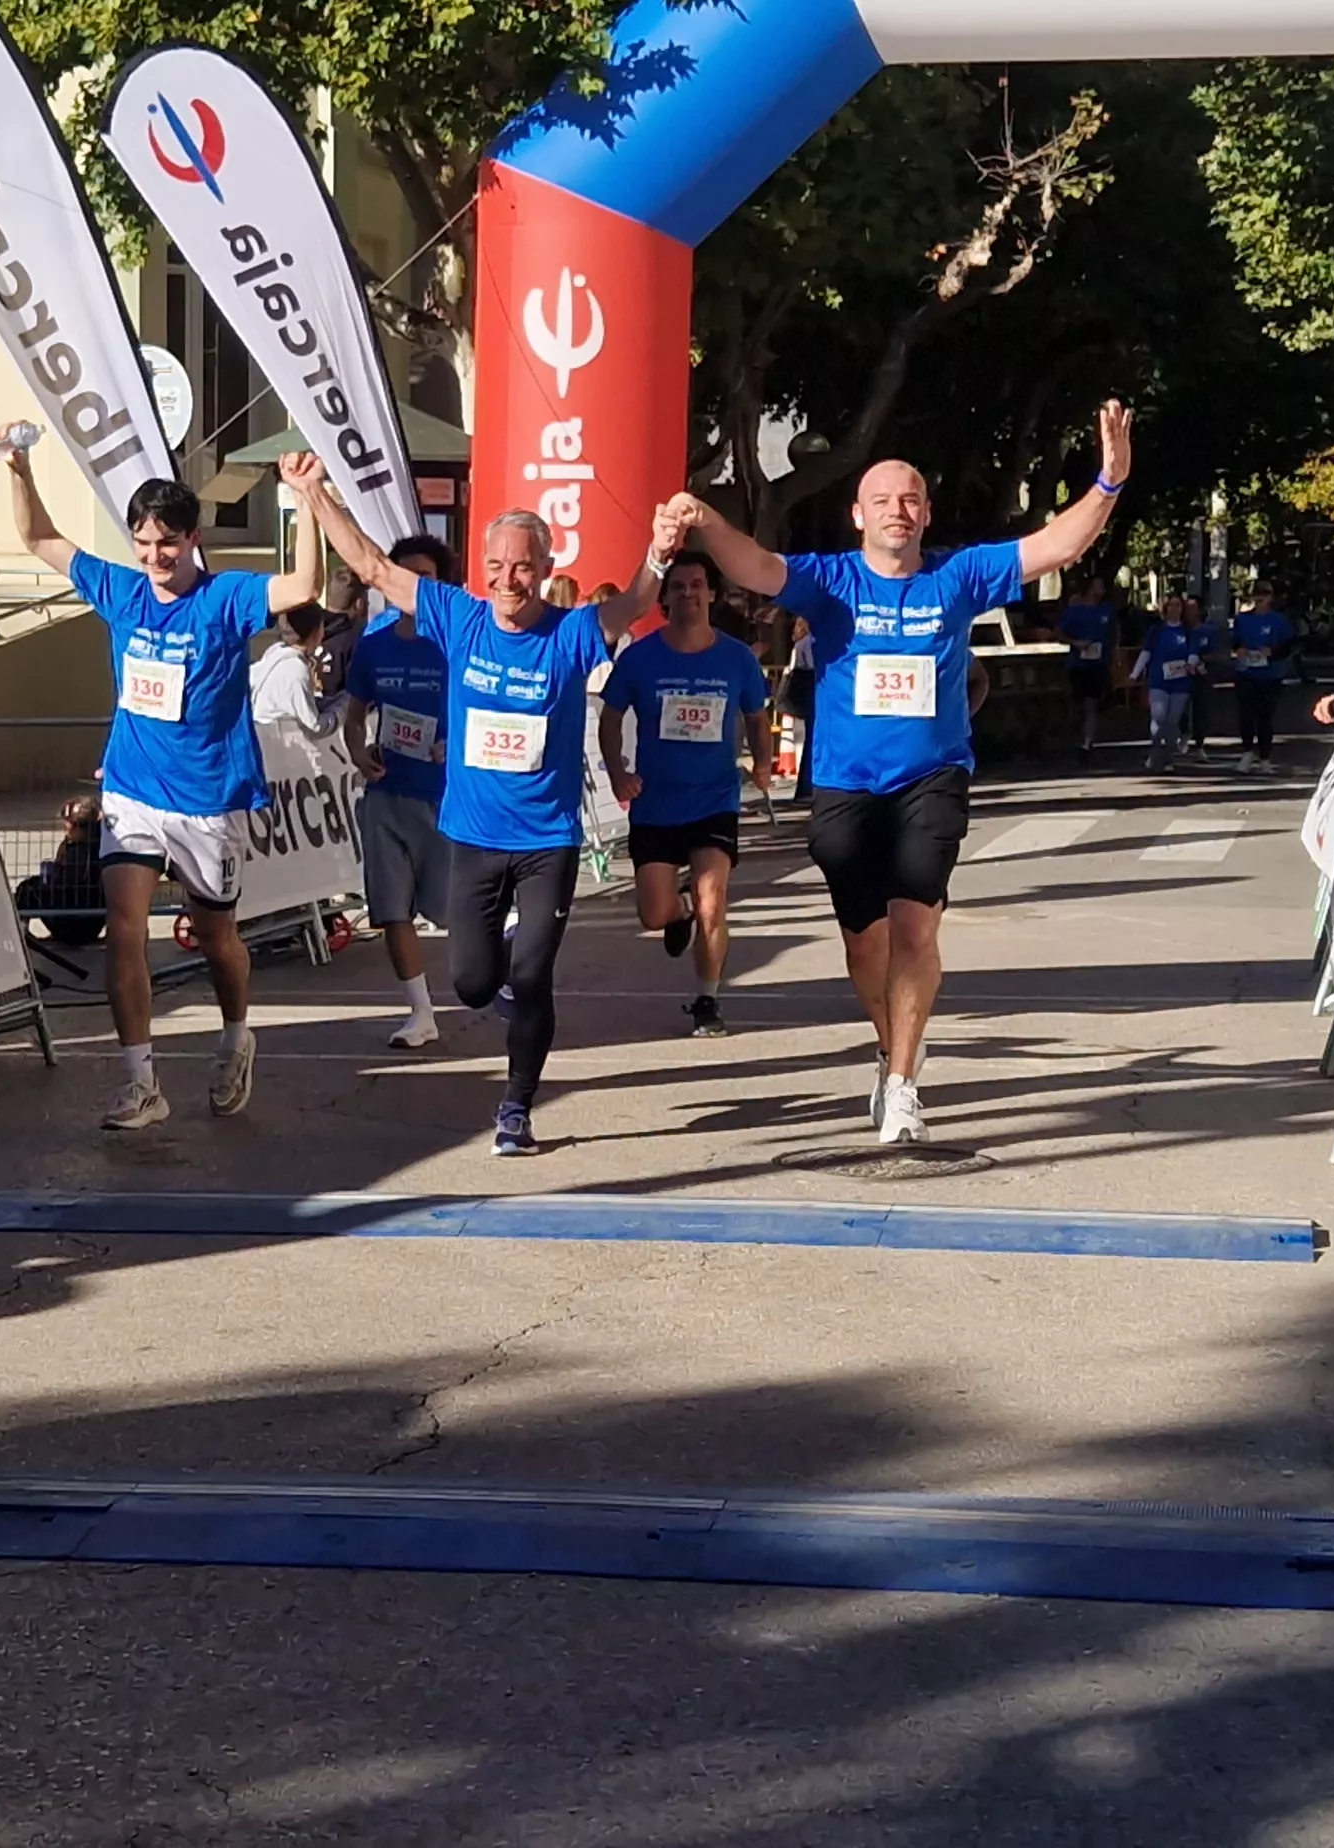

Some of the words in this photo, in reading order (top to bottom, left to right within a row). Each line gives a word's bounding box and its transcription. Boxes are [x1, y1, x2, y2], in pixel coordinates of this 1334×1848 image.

[874, 673, 915, 690] 331
[677, 708, 711, 722] 393
[484, 731, 526, 750] 332
[221, 856, 235, 879] 10
